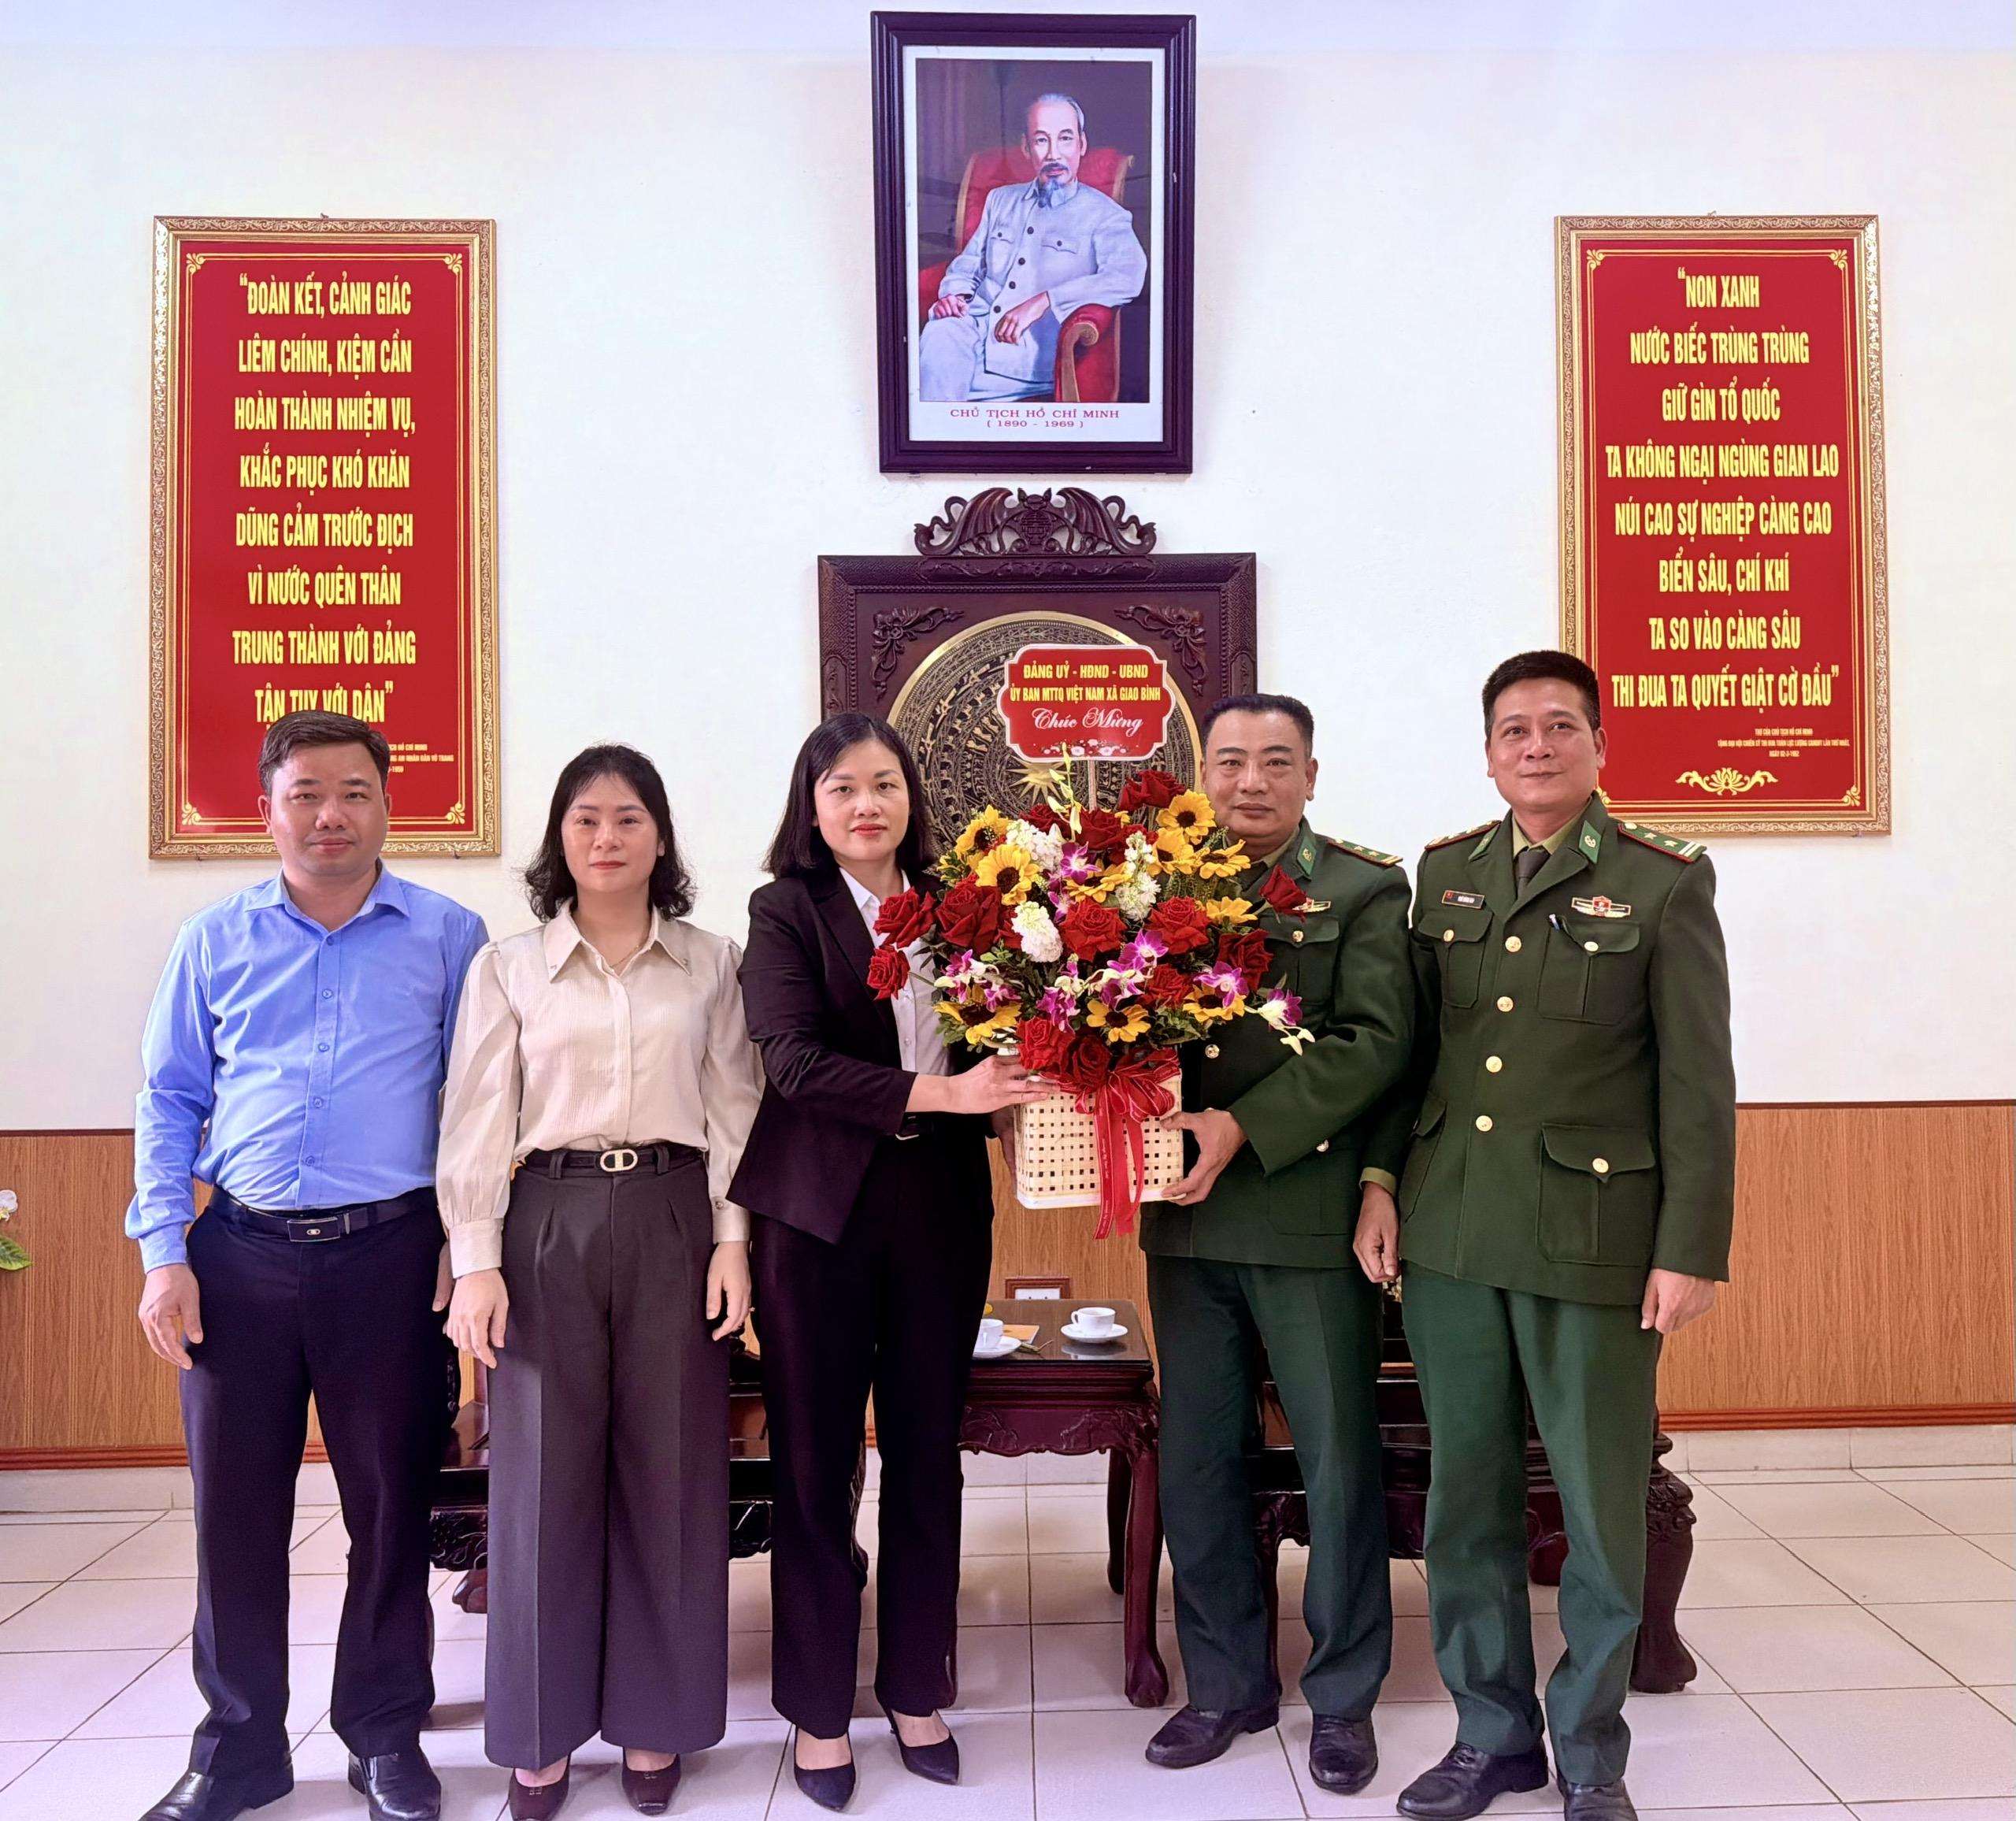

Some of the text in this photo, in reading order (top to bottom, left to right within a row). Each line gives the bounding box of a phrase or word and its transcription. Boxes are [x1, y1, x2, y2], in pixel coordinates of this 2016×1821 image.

[295, 272, 324, 318] KẾT,
[329, 271, 371, 314] CẢNH
[376, 275, 411, 314] GIÁC
[1721, 276, 1759, 307] XANH
[239, 328, 411, 380] LIÊM CHÍNH, KIỆM CẦN
[1631, 322, 1809, 364] NƯỚC BIẾC TRÙNG TRÙNG
[235, 391, 415, 437] HOÀN THÀNH NHIỆM VỤ,
[950, 406, 979, 417] CHỦ
[986, 410, 1020, 419] TỊCH
[1083, 410, 1119, 418] MINH
[1662, 376, 1780, 424] GIỮ GÌN TỔ QUỐC
[240, 443, 410, 495] KHẮC PHỤC KHÓ KHĂN
[1606, 439, 1839, 484] TA KHÔNG NGẠI NGÙNG GIAN LAO
[236, 503, 413, 554] DŨNG CẢM TRƯỚC ĐỊCH
[1615, 495, 1832, 542] NÚI CAO SỰ NGHIỆP CÀNG CAO
[248, 565, 401, 608] VÌ NƯỚC QUÊN THÂN
[1659, 547, 1789, 595] BIỂN SÂU, CHÍ KHÍ
[232, 620, 416, 664] TRUNG THÀNH VỚI ĐẢNG
[1649, 609, 1800, 650] TA SO VÀO CÀNG SÂU
[1024, 660, 1053, 679] ĐẢNG
[1080, 664, 1109, 679] HĐND
[1119, 664, 1148, 679] UBND
[1611, 675, 1634, 707] THI
[1638, 675, 1667, 707] ĐUA
[1670, 675, 1688, 707] TA
[1692, 664, 1737, 710] QUYẾT
[1741, 667, 1774, 713] GIẬT
[1778, 666, 1798, 706] CỜ
[323, 682, 348, 716] VỚI
[1023, 687, 1040, 702] BAN
[1042, 687, 1064, 703] MTTQ
[1065, 684, 1084, 704] VIỆT
[1085, 687, 1104, 701] NAM
[1106, 684, 1118, 701] XÃ
[1120, 687, 1139, 701] GIAO
[1140, 684, 1161, 701] BÌNH
[1032, 707, 1143, 737] Chúc Mừng
